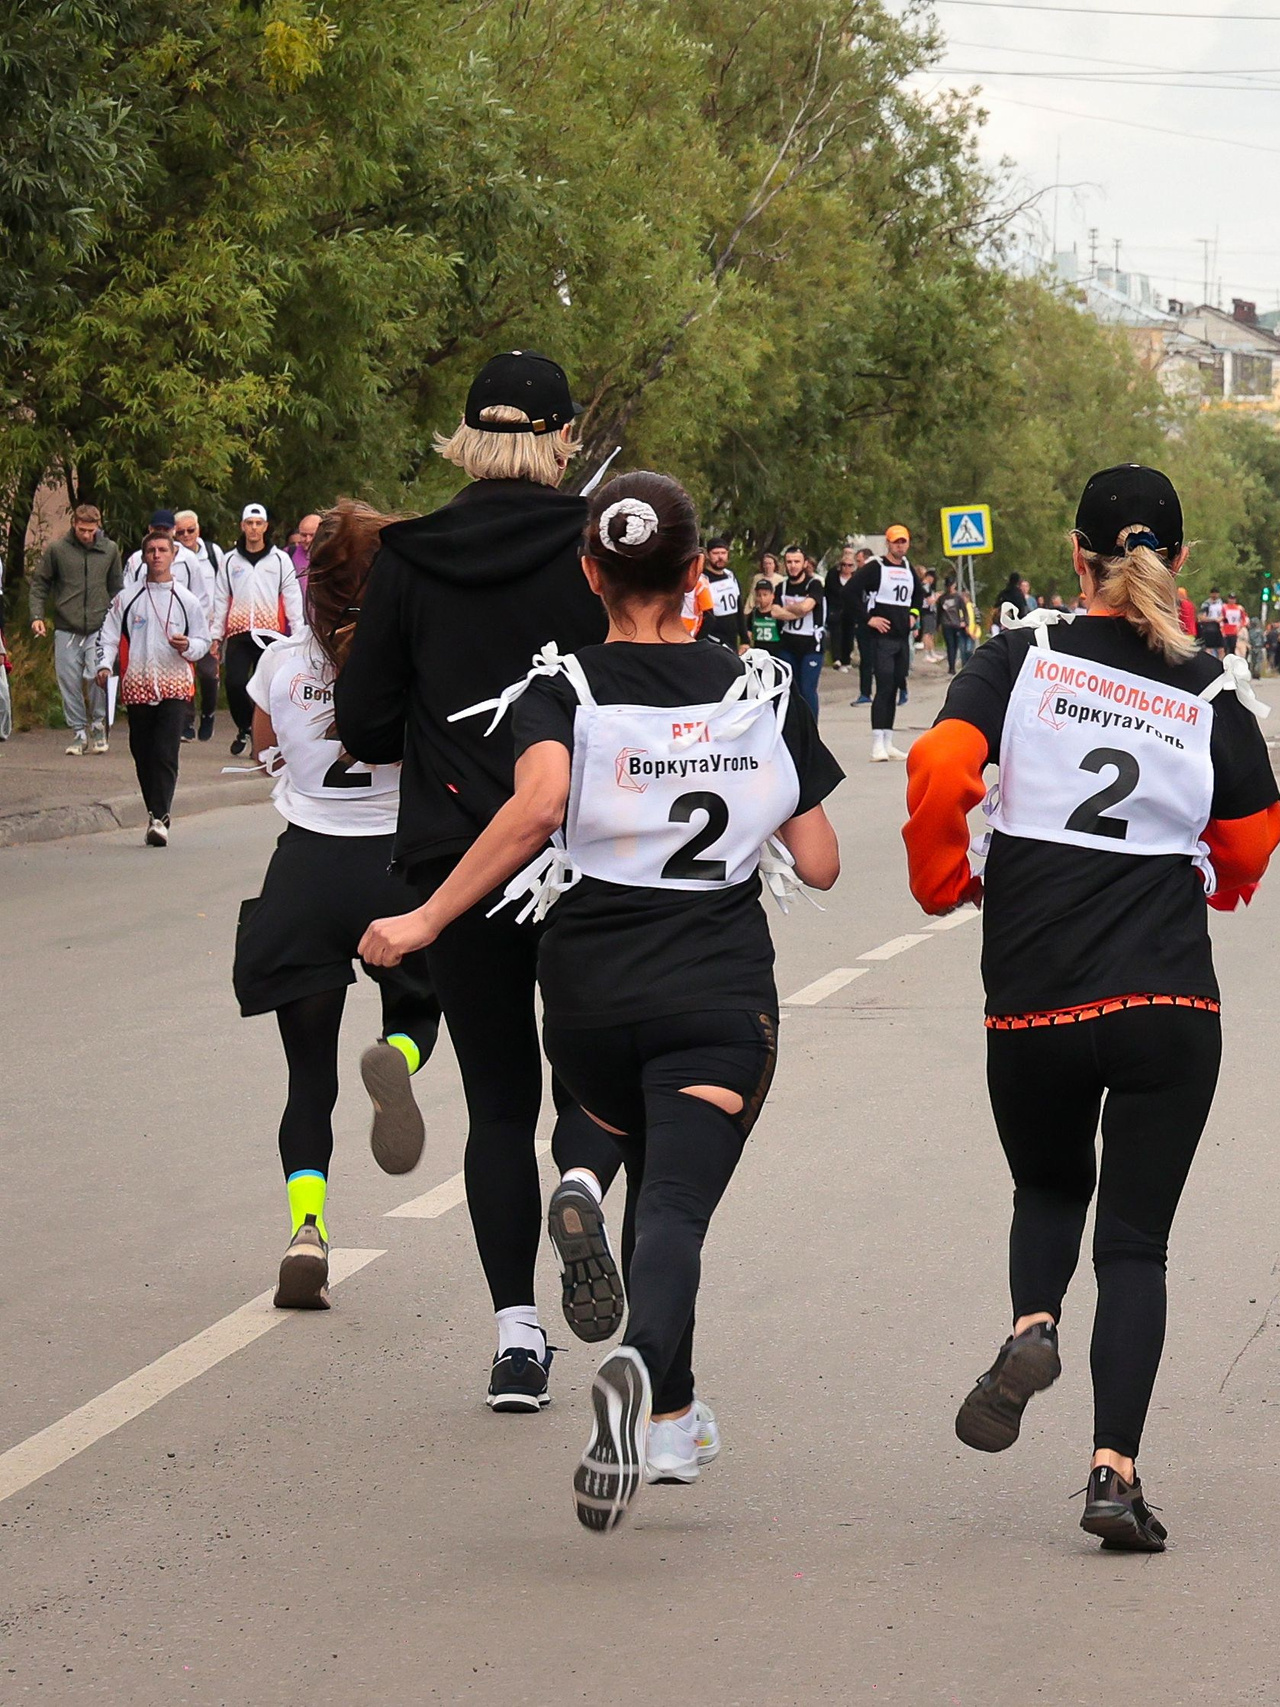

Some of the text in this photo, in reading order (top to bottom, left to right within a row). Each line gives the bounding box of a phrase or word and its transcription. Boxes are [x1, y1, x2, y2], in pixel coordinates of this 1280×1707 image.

[720, 593, 737, 612] 10
[893, 584, 909, 603] 10
[755, 627, 773, 641] 25
[1034, 659, 1200, 726] КОМСОМОЛЬСКАЯ
[1054, 698, 1185, 749] ВоркутаУголь
[629, 754, 759, 778] ВоркутаУголь
[1064, 747, 1140, 840] 2
[660, 791, 729, 881] 2
